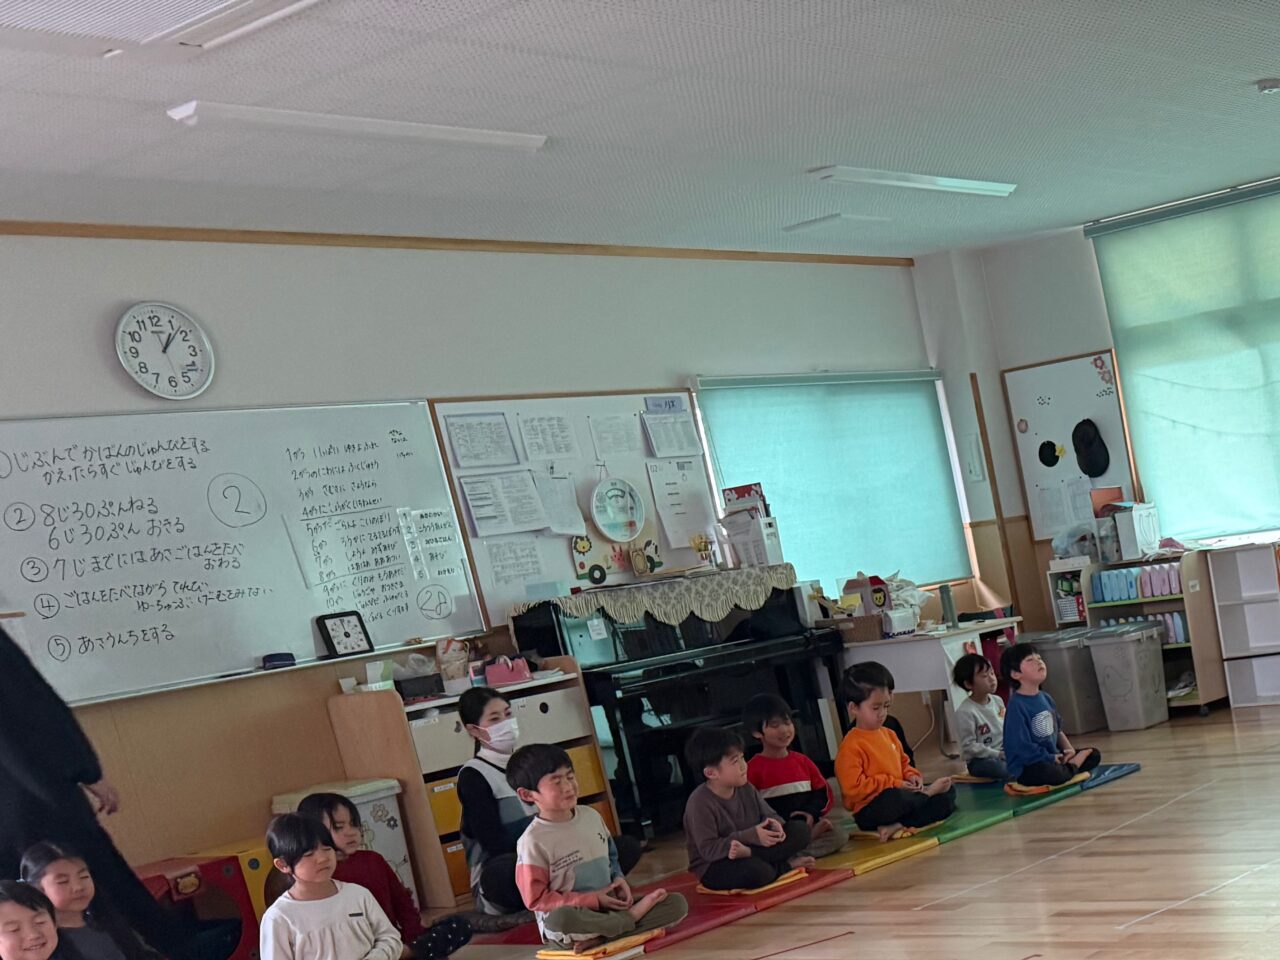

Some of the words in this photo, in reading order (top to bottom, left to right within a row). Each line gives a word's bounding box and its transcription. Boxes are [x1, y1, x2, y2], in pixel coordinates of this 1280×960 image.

[136, 319, 147, 331] 11
[147, 315, 163, 327] 12
[168, 319, 174, 331] 1
[128, 331, 141, 343] 10
[180, 330, 190, 342] 2
[129, 347, 139, 358] 9
[188, 345, 198, 357] 3
[138, 362, 148, 374] 8
[152, 373, 160, 384] 7
[168, 376, 178, 388] 6
[181, 372, 191, 383] 5
[147, 517, 185, 537] おきる
